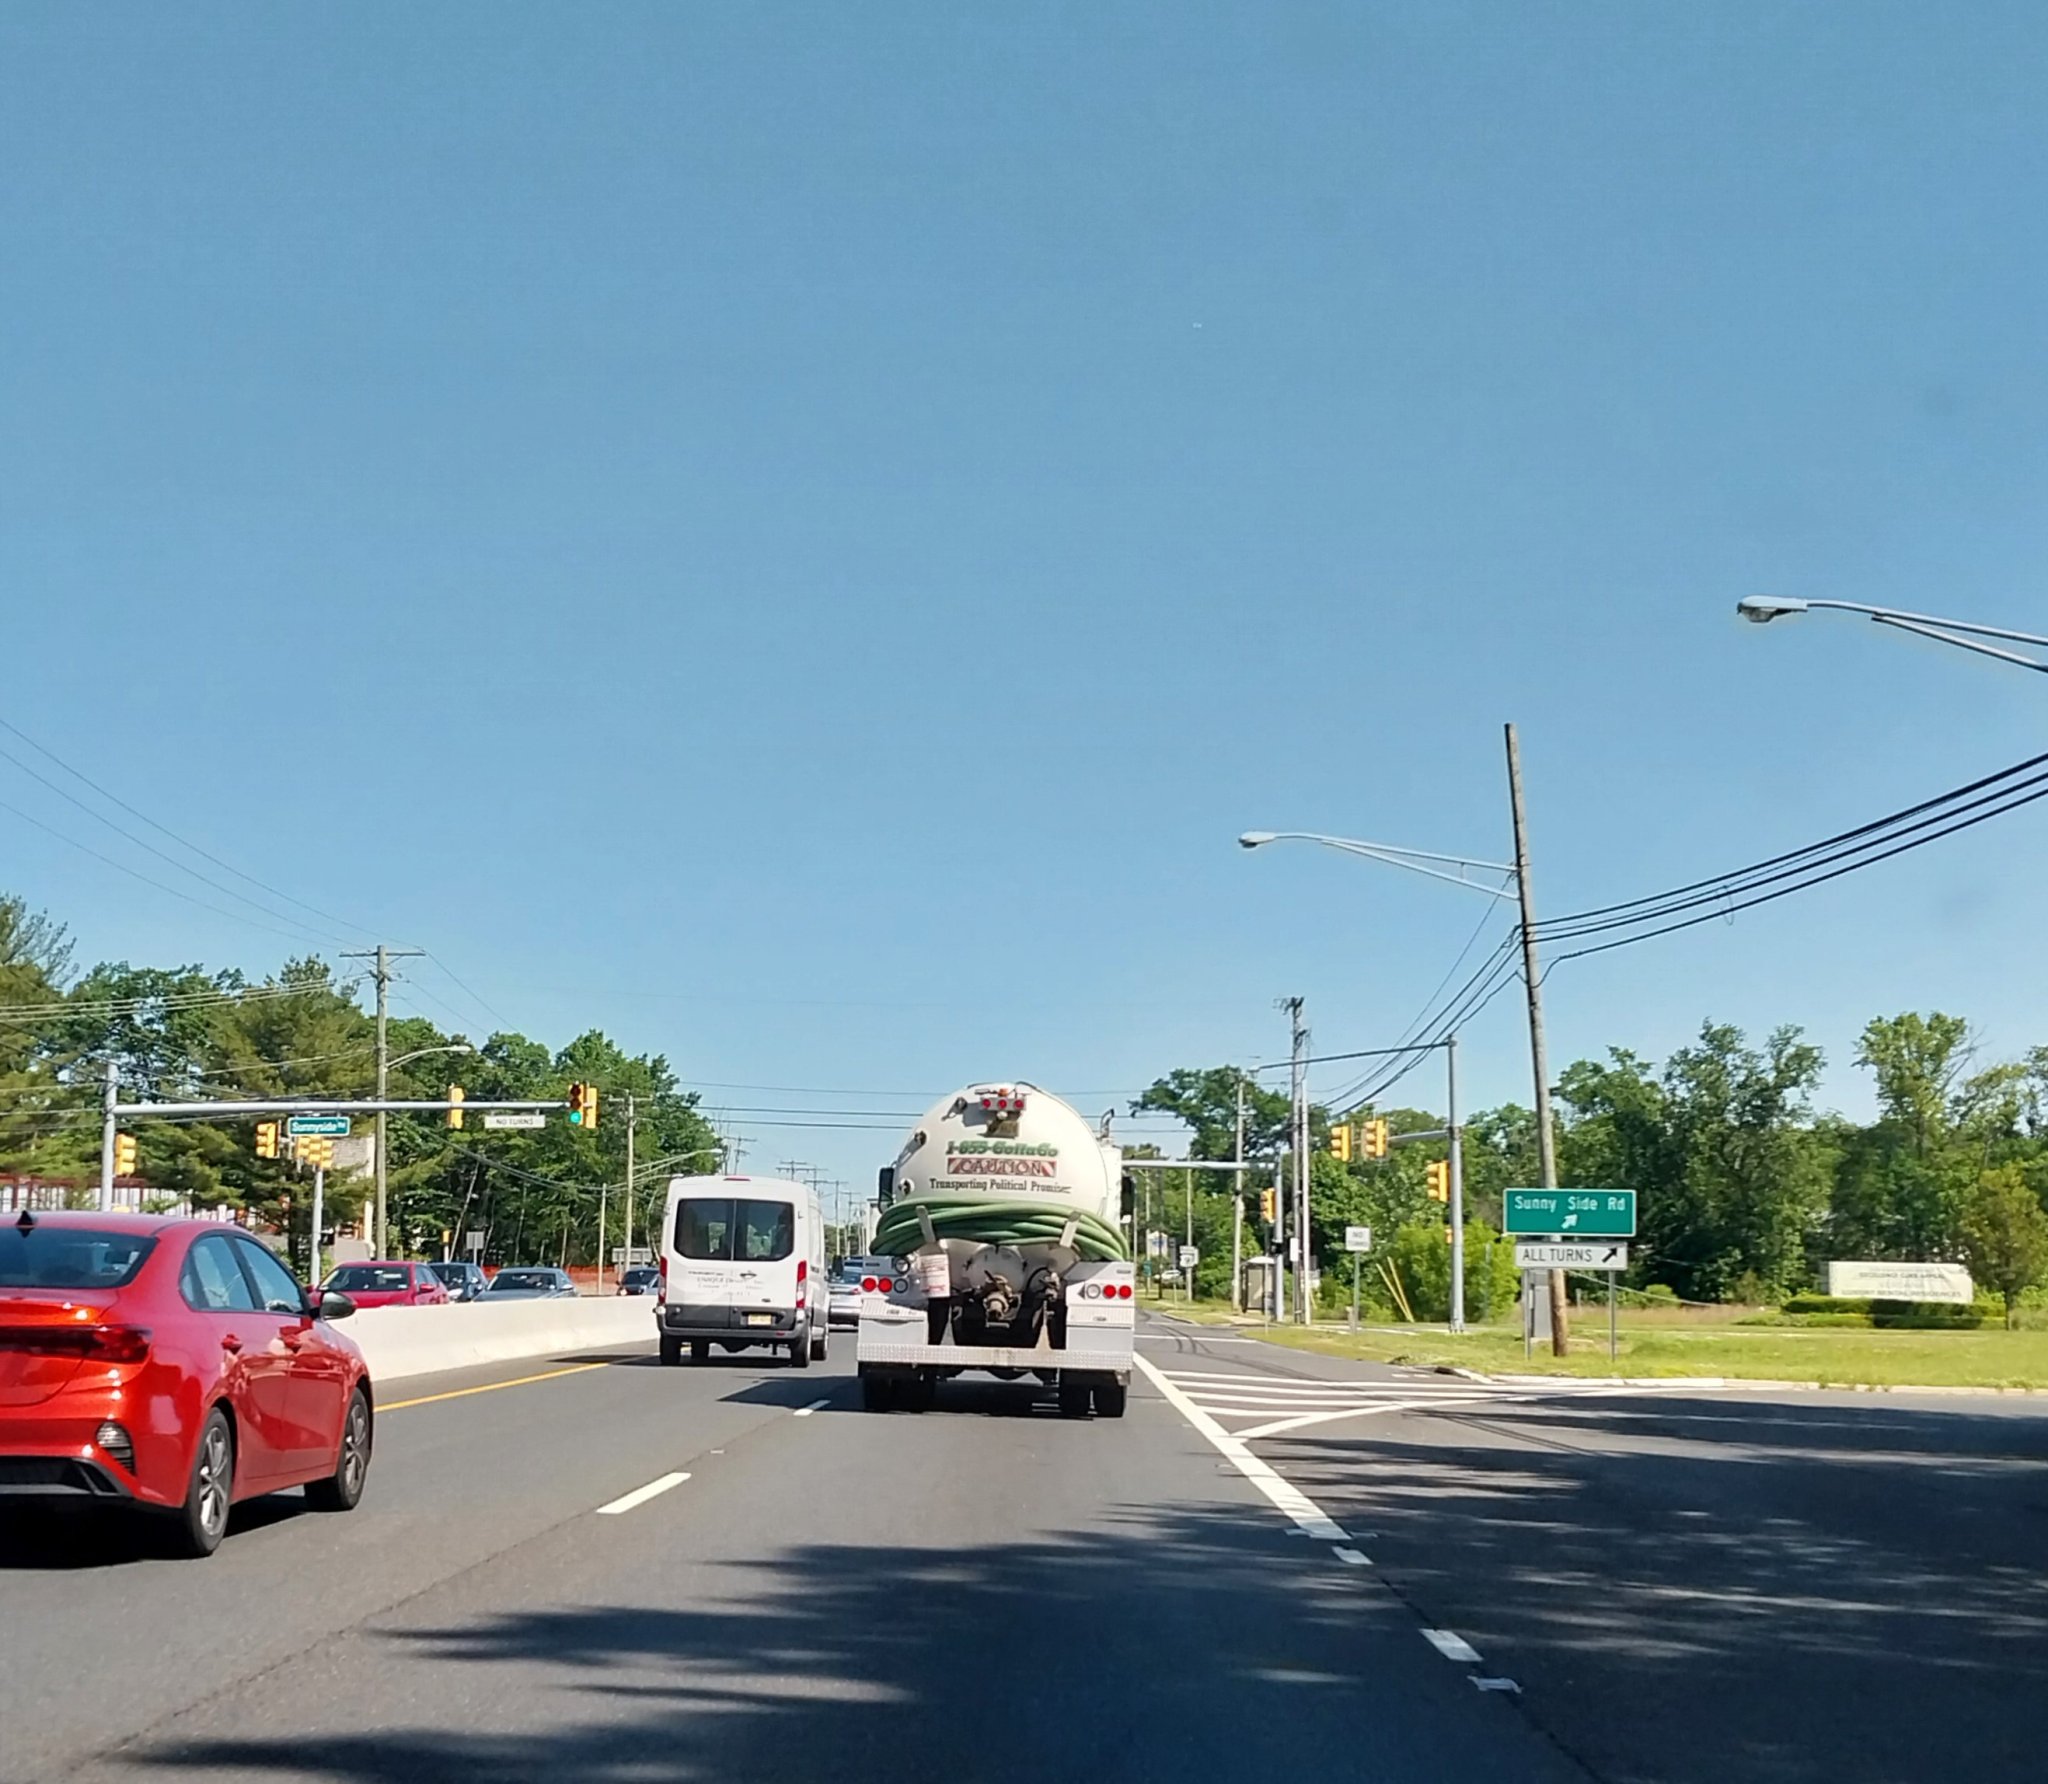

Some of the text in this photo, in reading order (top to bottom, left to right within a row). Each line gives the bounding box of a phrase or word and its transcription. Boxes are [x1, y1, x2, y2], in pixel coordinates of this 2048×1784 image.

[509, 1118, 534, 1126] TURNS
[959, 1159, 1043, 1176] CAUTION
[929, 1178, 987, 1192] Transporting
[989, 1178, 1027, 1192] Political
[1514, 1195, 1626, 1213] Sunny Side Rd
[1522, 1248, 1593, 1262] ALL TURNS
